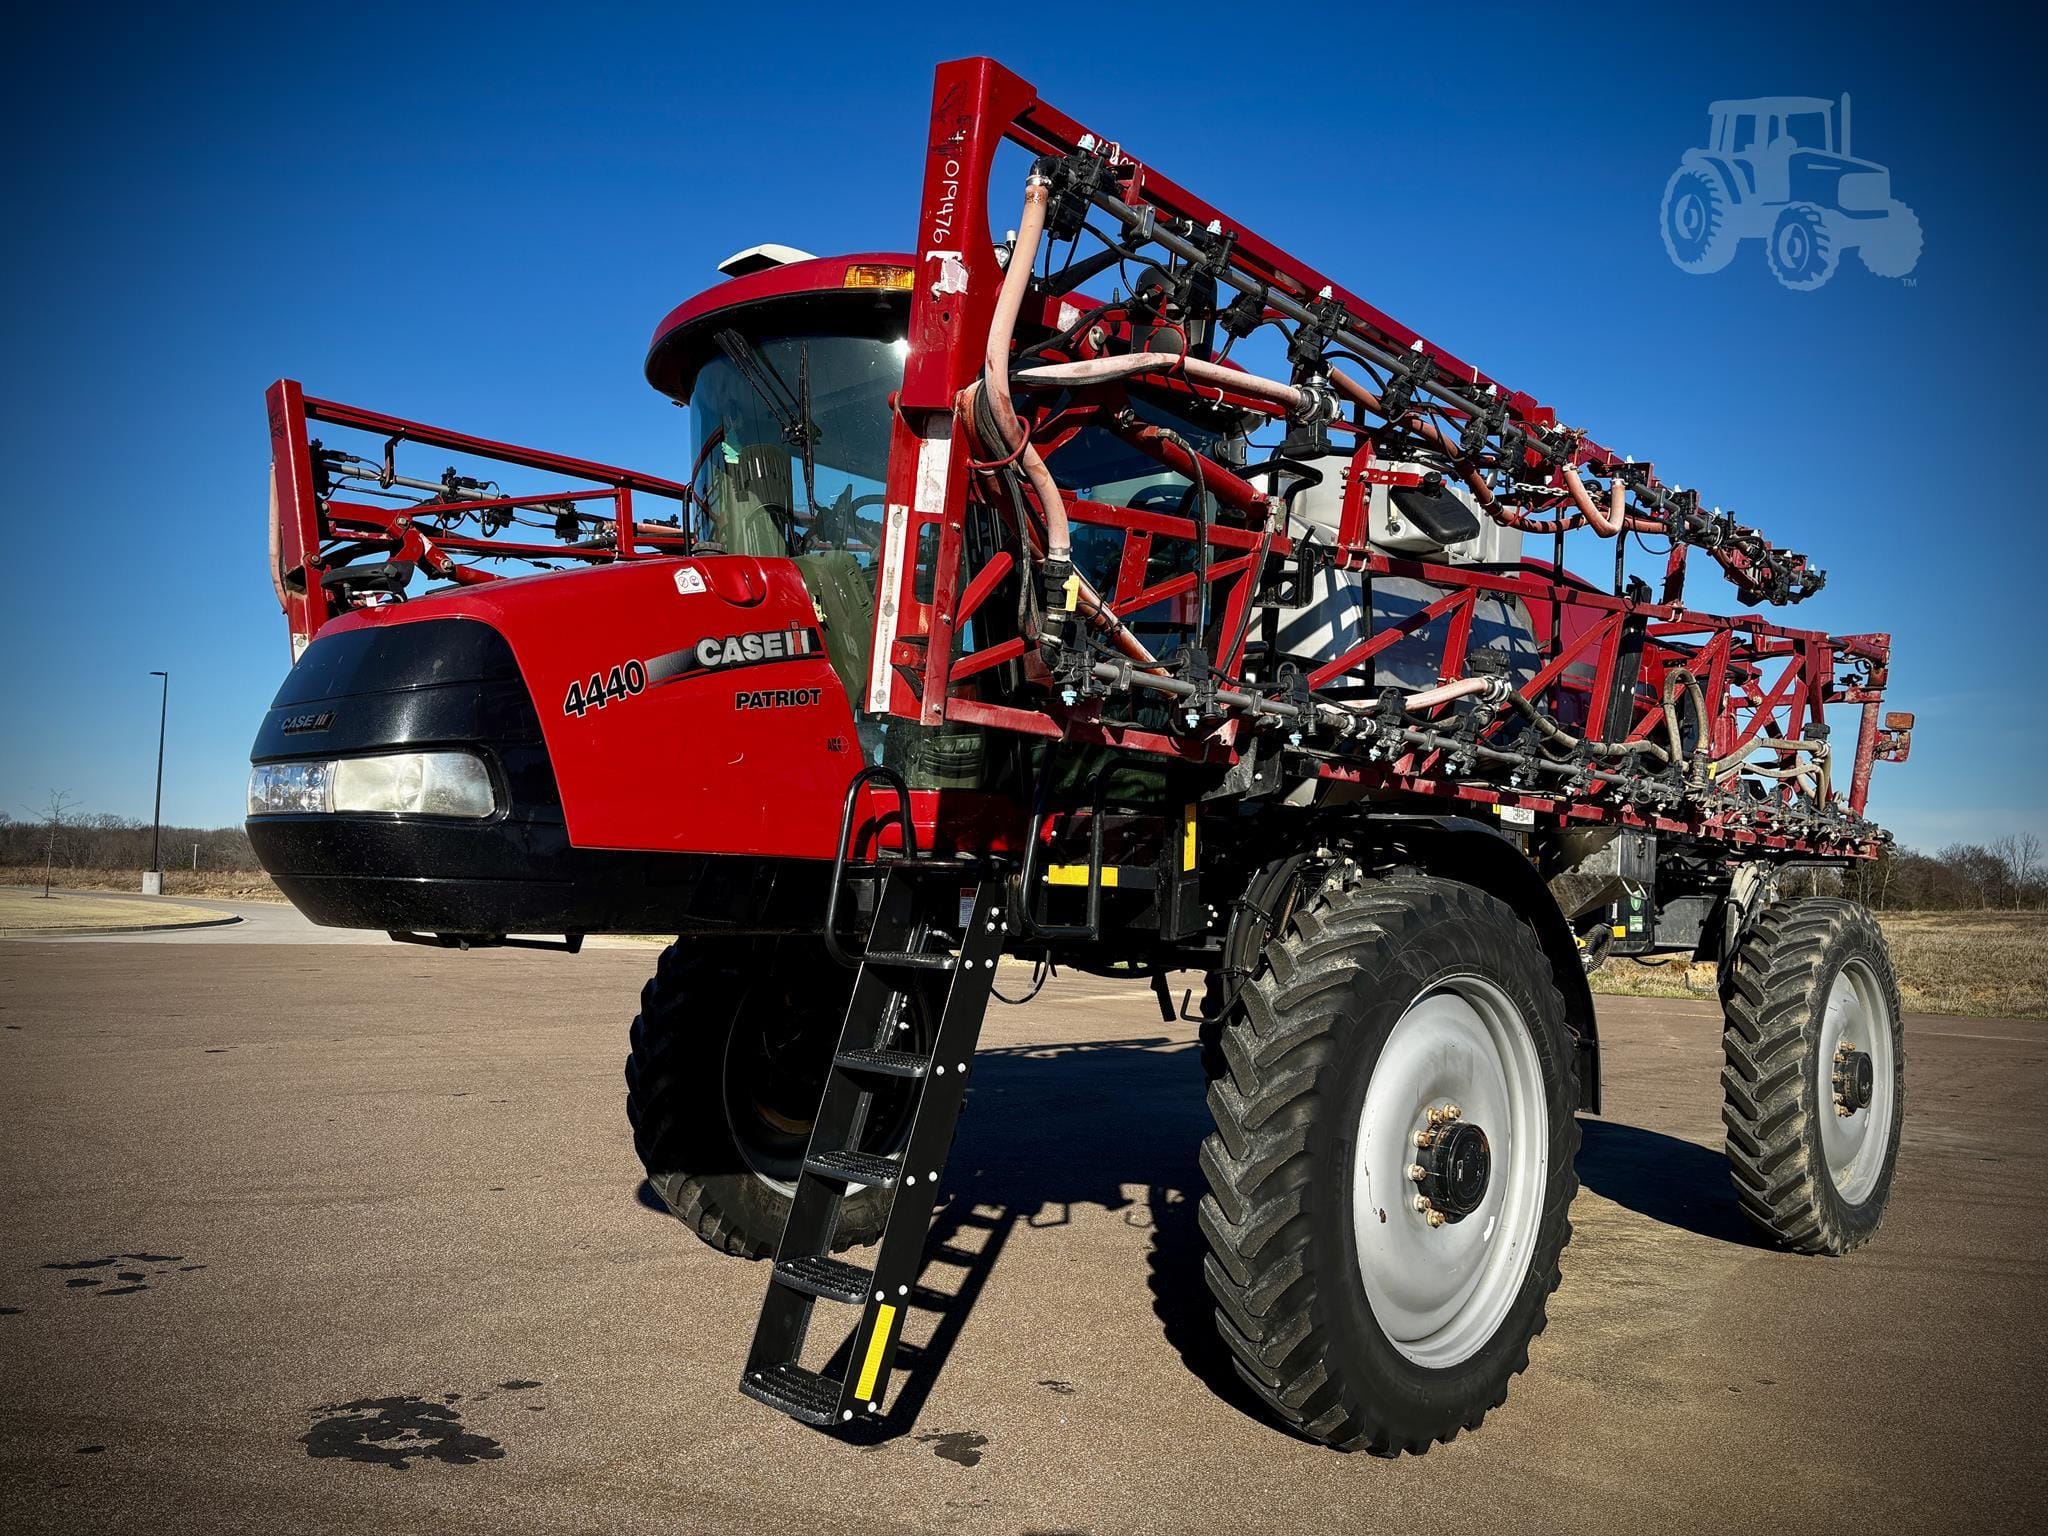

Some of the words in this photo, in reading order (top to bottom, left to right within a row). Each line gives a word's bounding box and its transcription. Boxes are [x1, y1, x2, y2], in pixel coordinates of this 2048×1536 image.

[696, 631, 783, 668] CASE
[564, 659, 646, 718] 4440
[735, 688, 822, 711] PATRIOT
[281, 715, 315, 730] CASE
